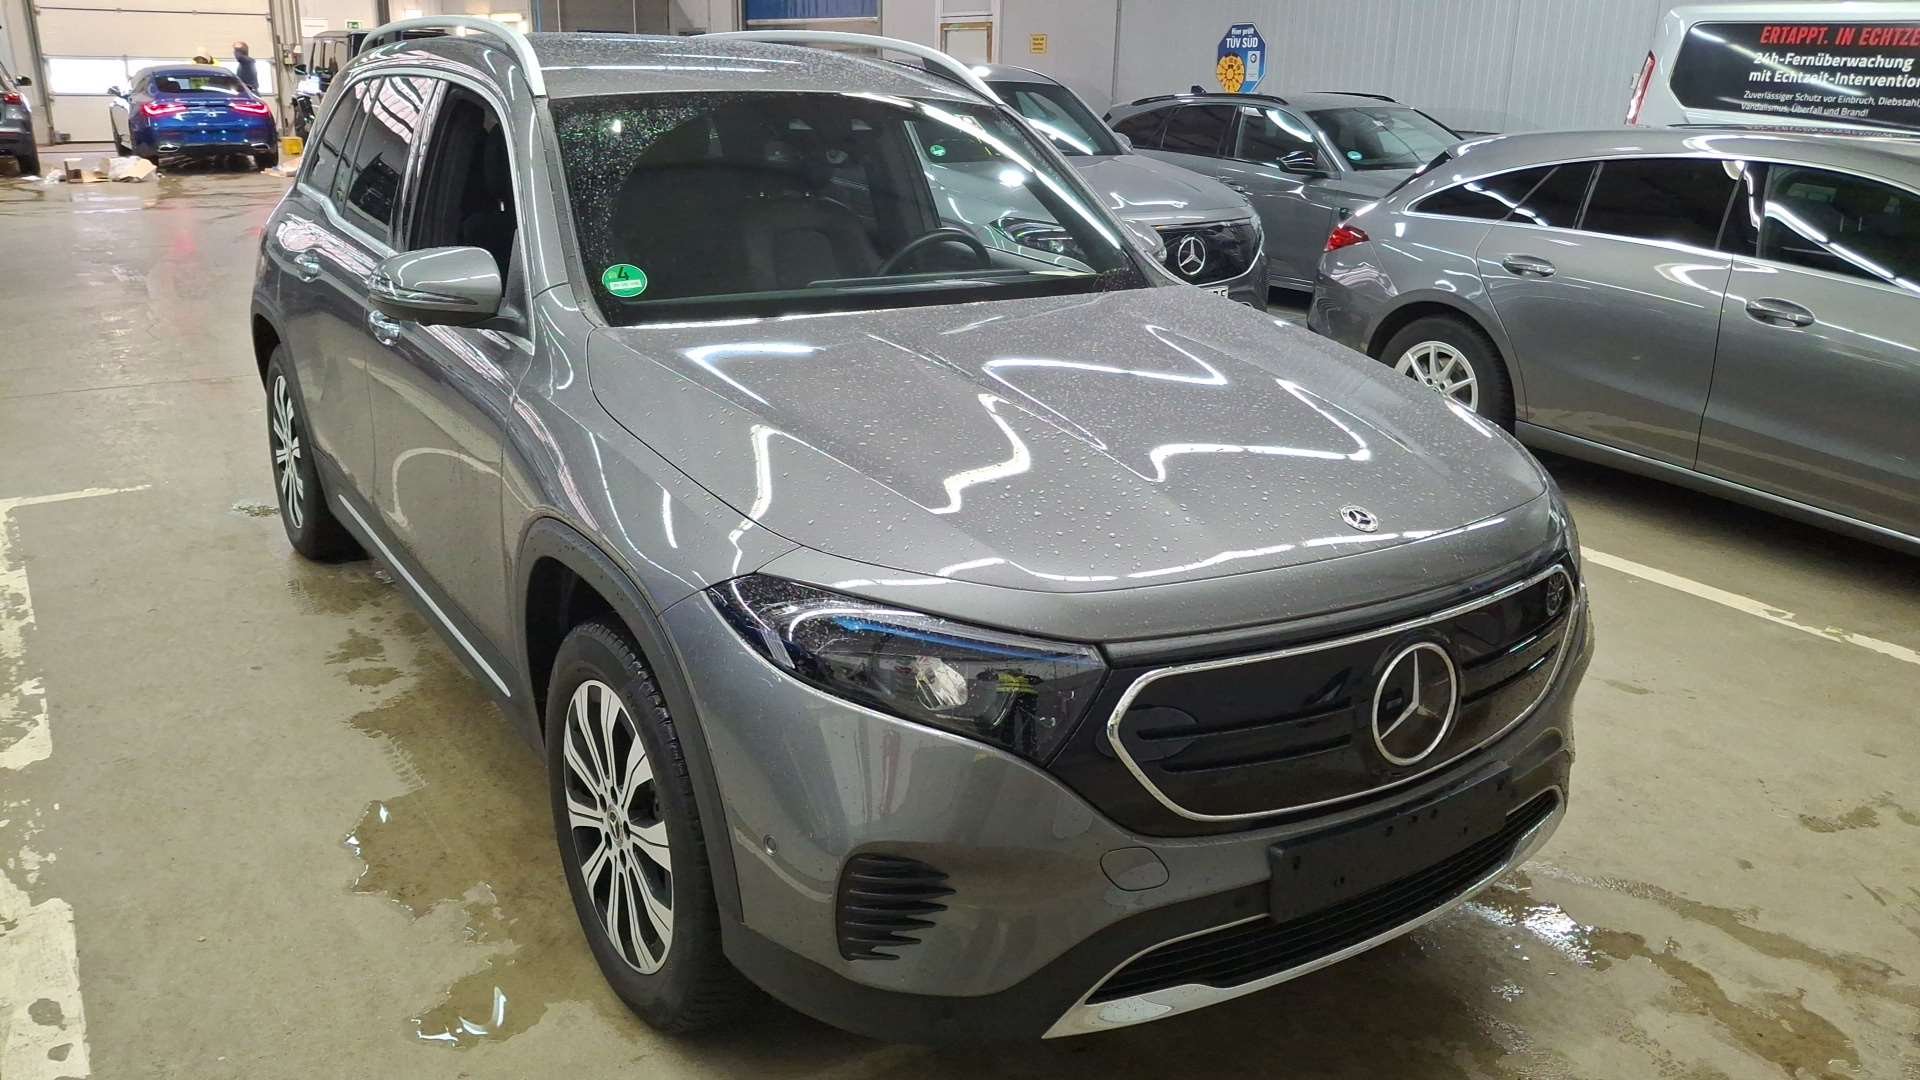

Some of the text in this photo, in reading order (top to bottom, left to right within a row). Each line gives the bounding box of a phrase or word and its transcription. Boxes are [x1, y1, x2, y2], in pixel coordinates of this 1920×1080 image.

[1226, 35, 1258, 48] TÜV SÜD
[1760, 26, 1829, 45] ERTAPPT.
[1835, 27, 1856, 46] IN
[1753, 52, 1915, 72] 24h-Fernüberwachung
[1748, 70, 1772, 82] mit
[1743, 90, 1794, 102] Zuverlässiger
[1795, 92, 1821, 102] Schutz
[1838, 95, 1876, 106] Einbruch,
[1791, 102, 1823, 115] Überfall
[1823, 106, 1840, 116] und
[618, 267, 629, 280] 4
